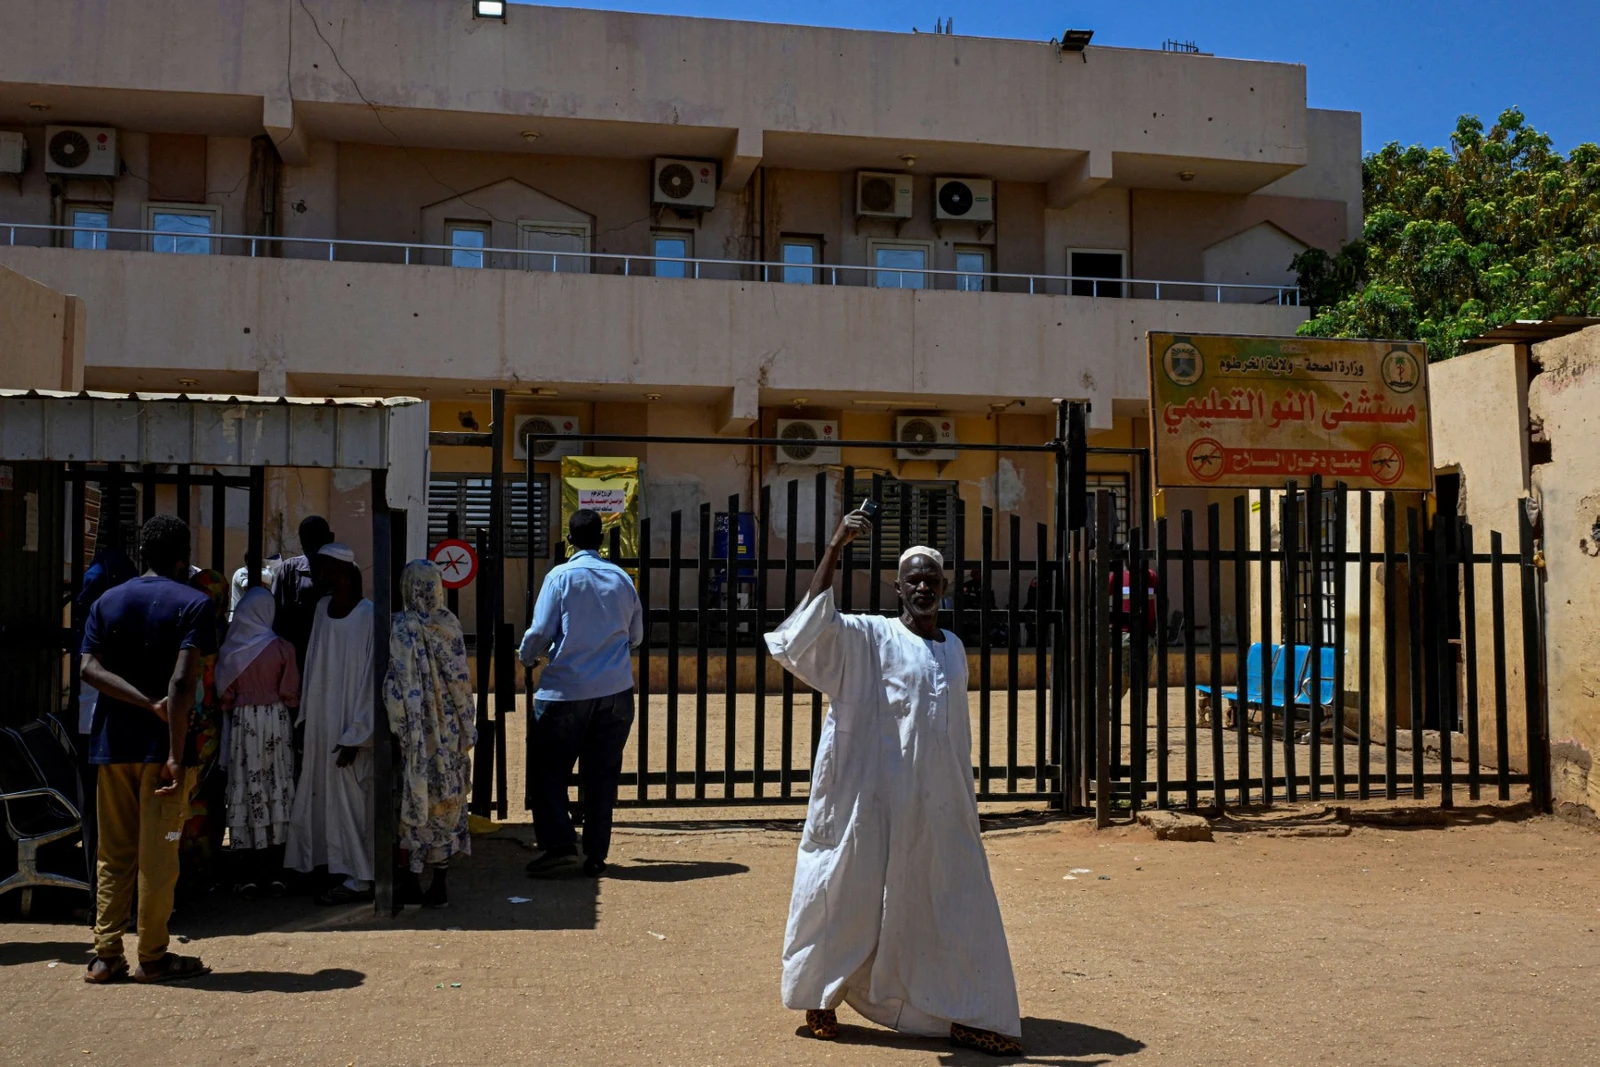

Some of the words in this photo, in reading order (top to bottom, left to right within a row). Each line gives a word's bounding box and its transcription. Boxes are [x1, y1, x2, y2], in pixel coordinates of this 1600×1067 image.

[1219, 356, 1264, 374] الخرطوم
[1266, 356, 1294, 376] ولاية
[1305, 358, 1337, 373] الصحة
[1340, 360, 1364, 376] وزارة
[1163, 388, 1264, 434] التعليمي
[1268, 389, 1315, 429] النو
[1321, 388, 1416, 431] مستشفى
[1232, 452, 1285, 472] السلاح
[1287, 452, 1326, 472] دخول
[1329, 453, 1362, 474] يمنع
